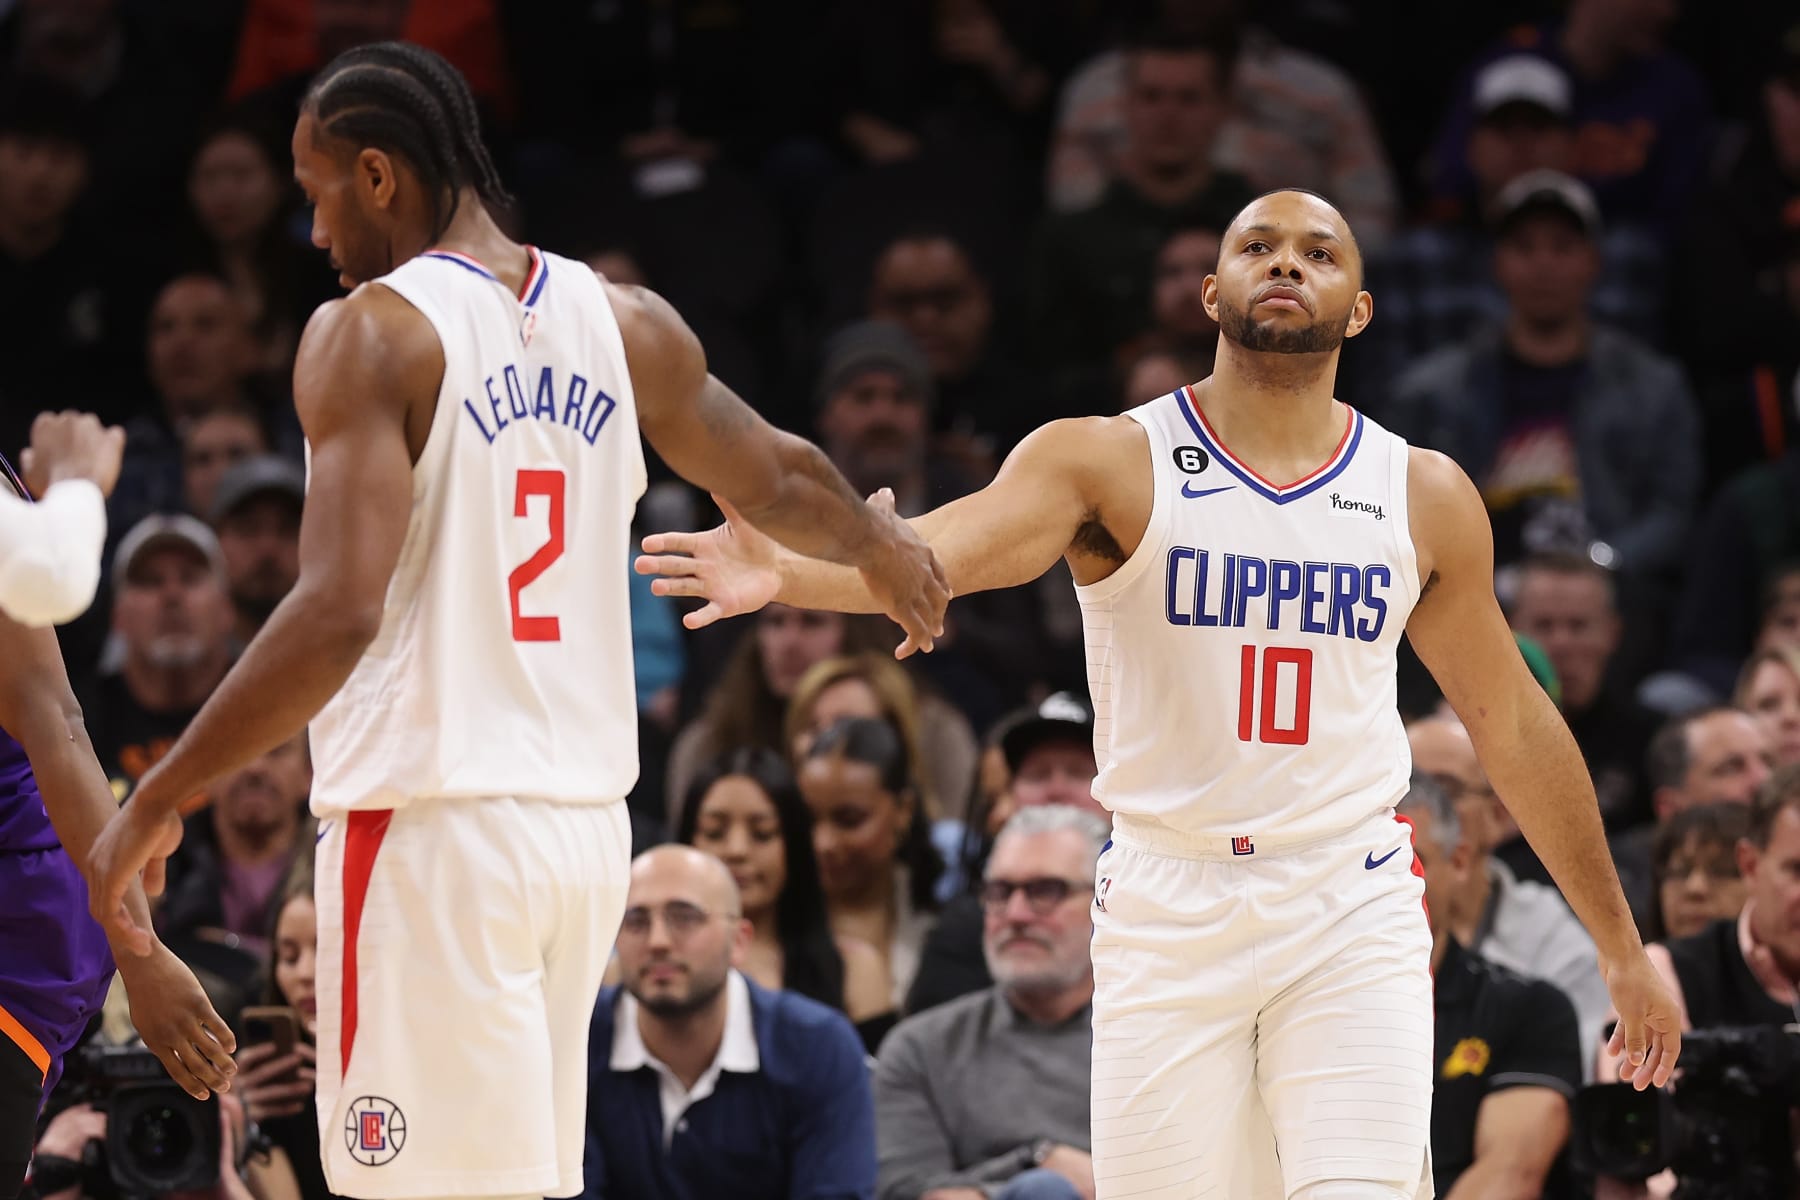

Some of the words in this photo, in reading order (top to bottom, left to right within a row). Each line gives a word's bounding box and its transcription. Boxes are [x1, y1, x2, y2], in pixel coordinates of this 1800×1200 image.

[1180, 450, 1201, 472] 6
[1329, 493, 1386, 520] honey
[508, 469, 565, 641] 2
[1165, 545, 1391, 642] CLIPPERS
[1238, 644, 1313, 745] 10
